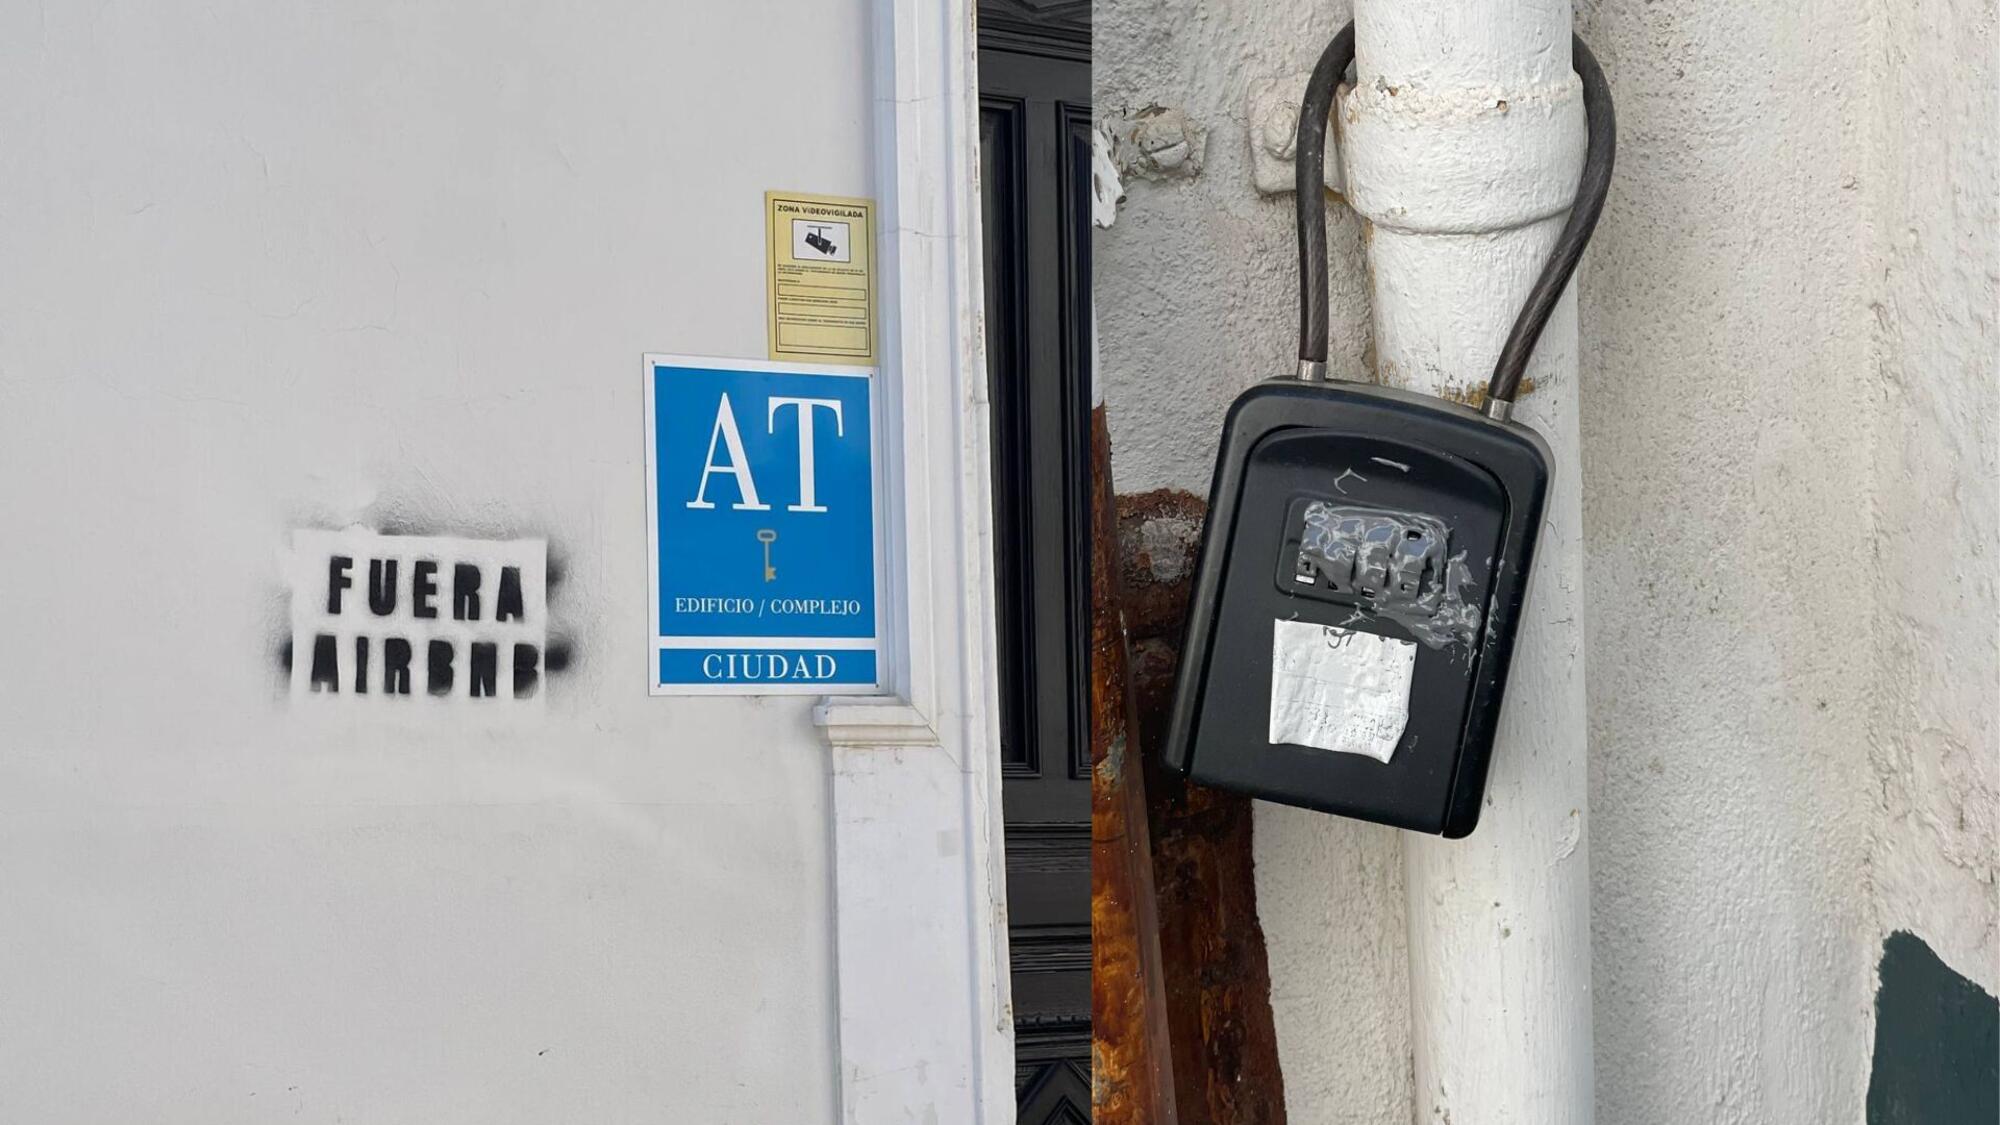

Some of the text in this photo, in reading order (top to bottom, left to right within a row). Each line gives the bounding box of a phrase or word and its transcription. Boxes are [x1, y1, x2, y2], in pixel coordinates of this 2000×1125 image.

[777, 204, 800, 213] ZONA
[686, 392, 843, 513] AT
[327, 555, 525, 623] FUERA
[675, 597, 754, 614] EDIFICIO
[770, 599, 861, 616] COMPLEJO
[310, 634, 540, 698] AIRBNB
[703, 654, 837, 680] CIUDAD
